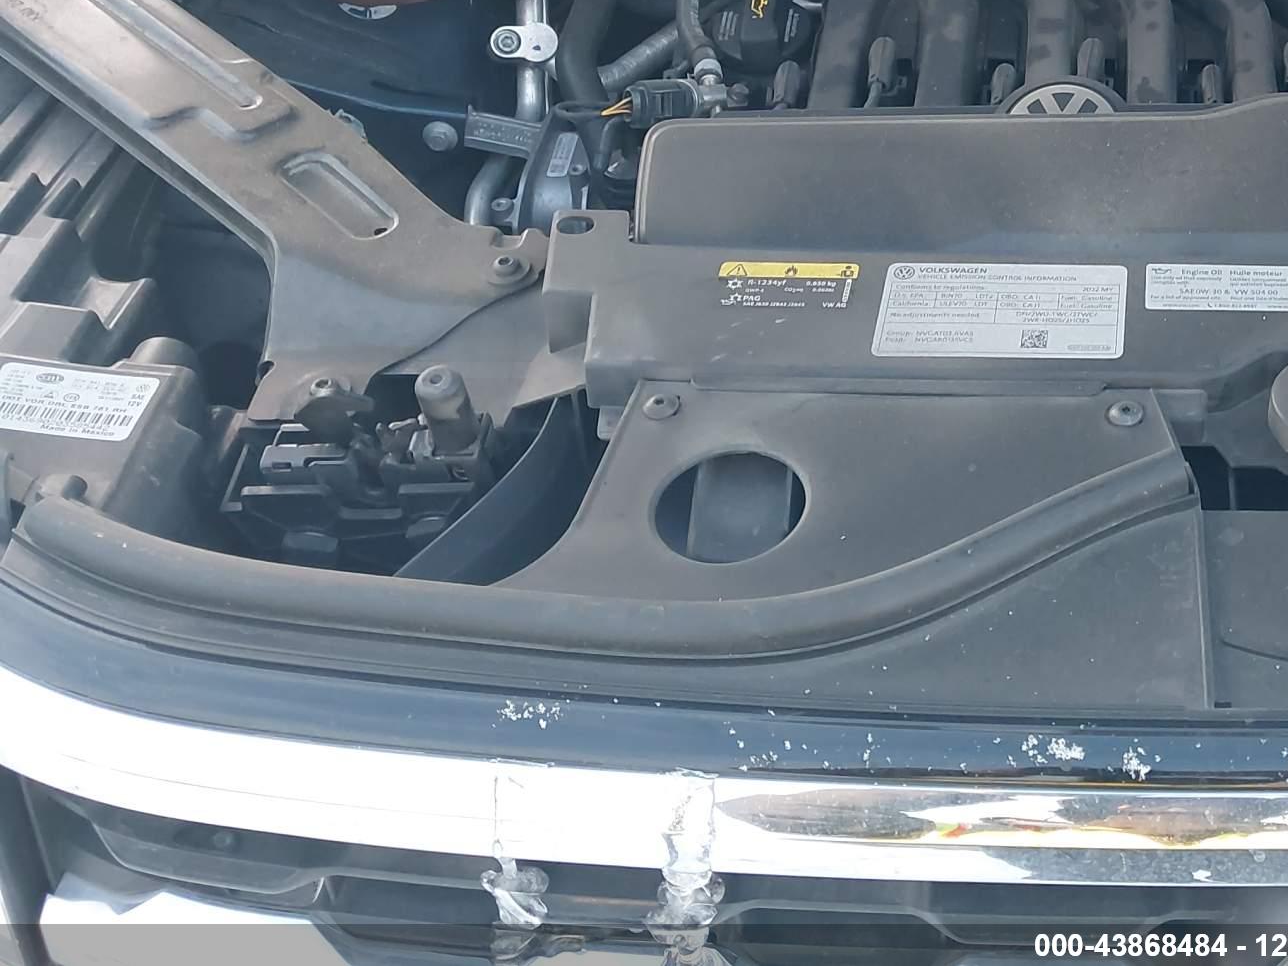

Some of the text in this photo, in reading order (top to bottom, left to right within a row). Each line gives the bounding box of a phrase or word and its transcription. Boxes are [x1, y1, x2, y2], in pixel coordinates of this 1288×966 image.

[1181, 269, 1209, 277] Engine
[40, 423, 66, 432] Made
[81, 428, 115, 437] Mexico
